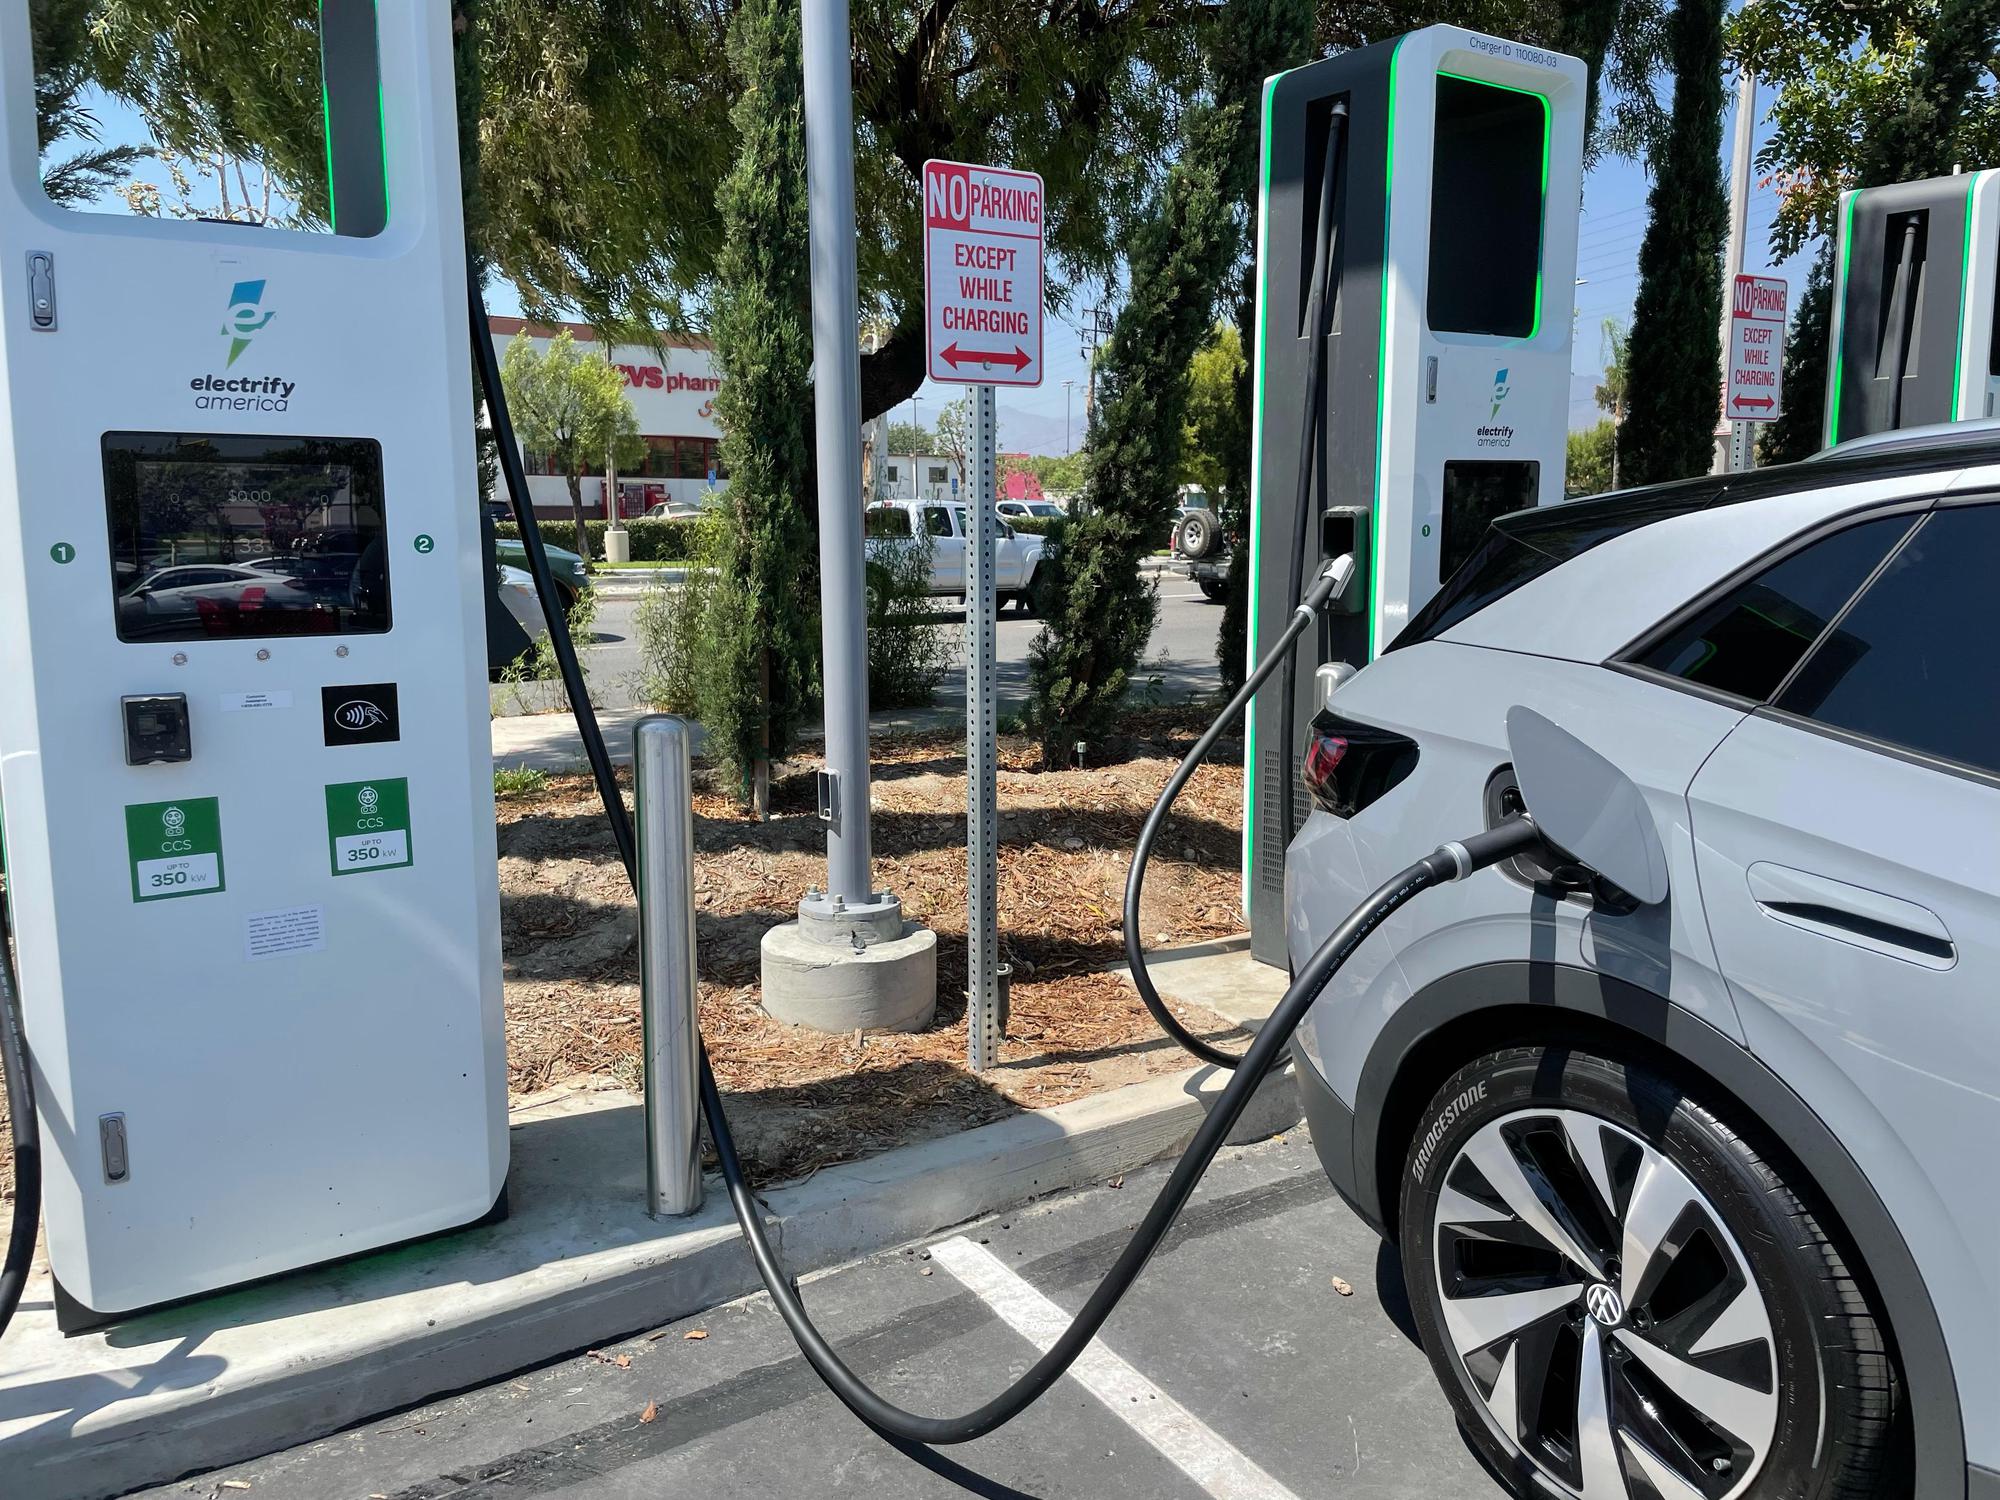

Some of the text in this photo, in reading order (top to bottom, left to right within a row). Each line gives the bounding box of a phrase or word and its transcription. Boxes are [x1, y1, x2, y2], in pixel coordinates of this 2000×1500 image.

[1469, 36, 1557, 68] Charger ID 110080-03
[928, 171, 1039, 224] NO PARKING
[954, 243, 1017, 272] EXCEPT
[959, 276, 1013, 303] WHILE
[1734, 281, 1785, 313] NO PARKING
[943, 306, 1029, 335] CHARGING
[1743, 327, 1773, 345] EXCEPT
[1744, 348, 1769, 365] WHILE
[190, 374, 296, 399] electrify
[1735, 369, 1775, 387] CHARGING
[195, 395, 289, 412] america
[1477, 425, 1514, 439] electrify
[1477, 438, 1511, 447] america
[357, 817, 384, 829] CCS
[161, 839, 192, 852] CCS
[347, 847, 397, 862] 350 kW
[151, 871, 207, 887] 350 kW
[1411, 1080, 1488, 1185] BRIDGESTONE
